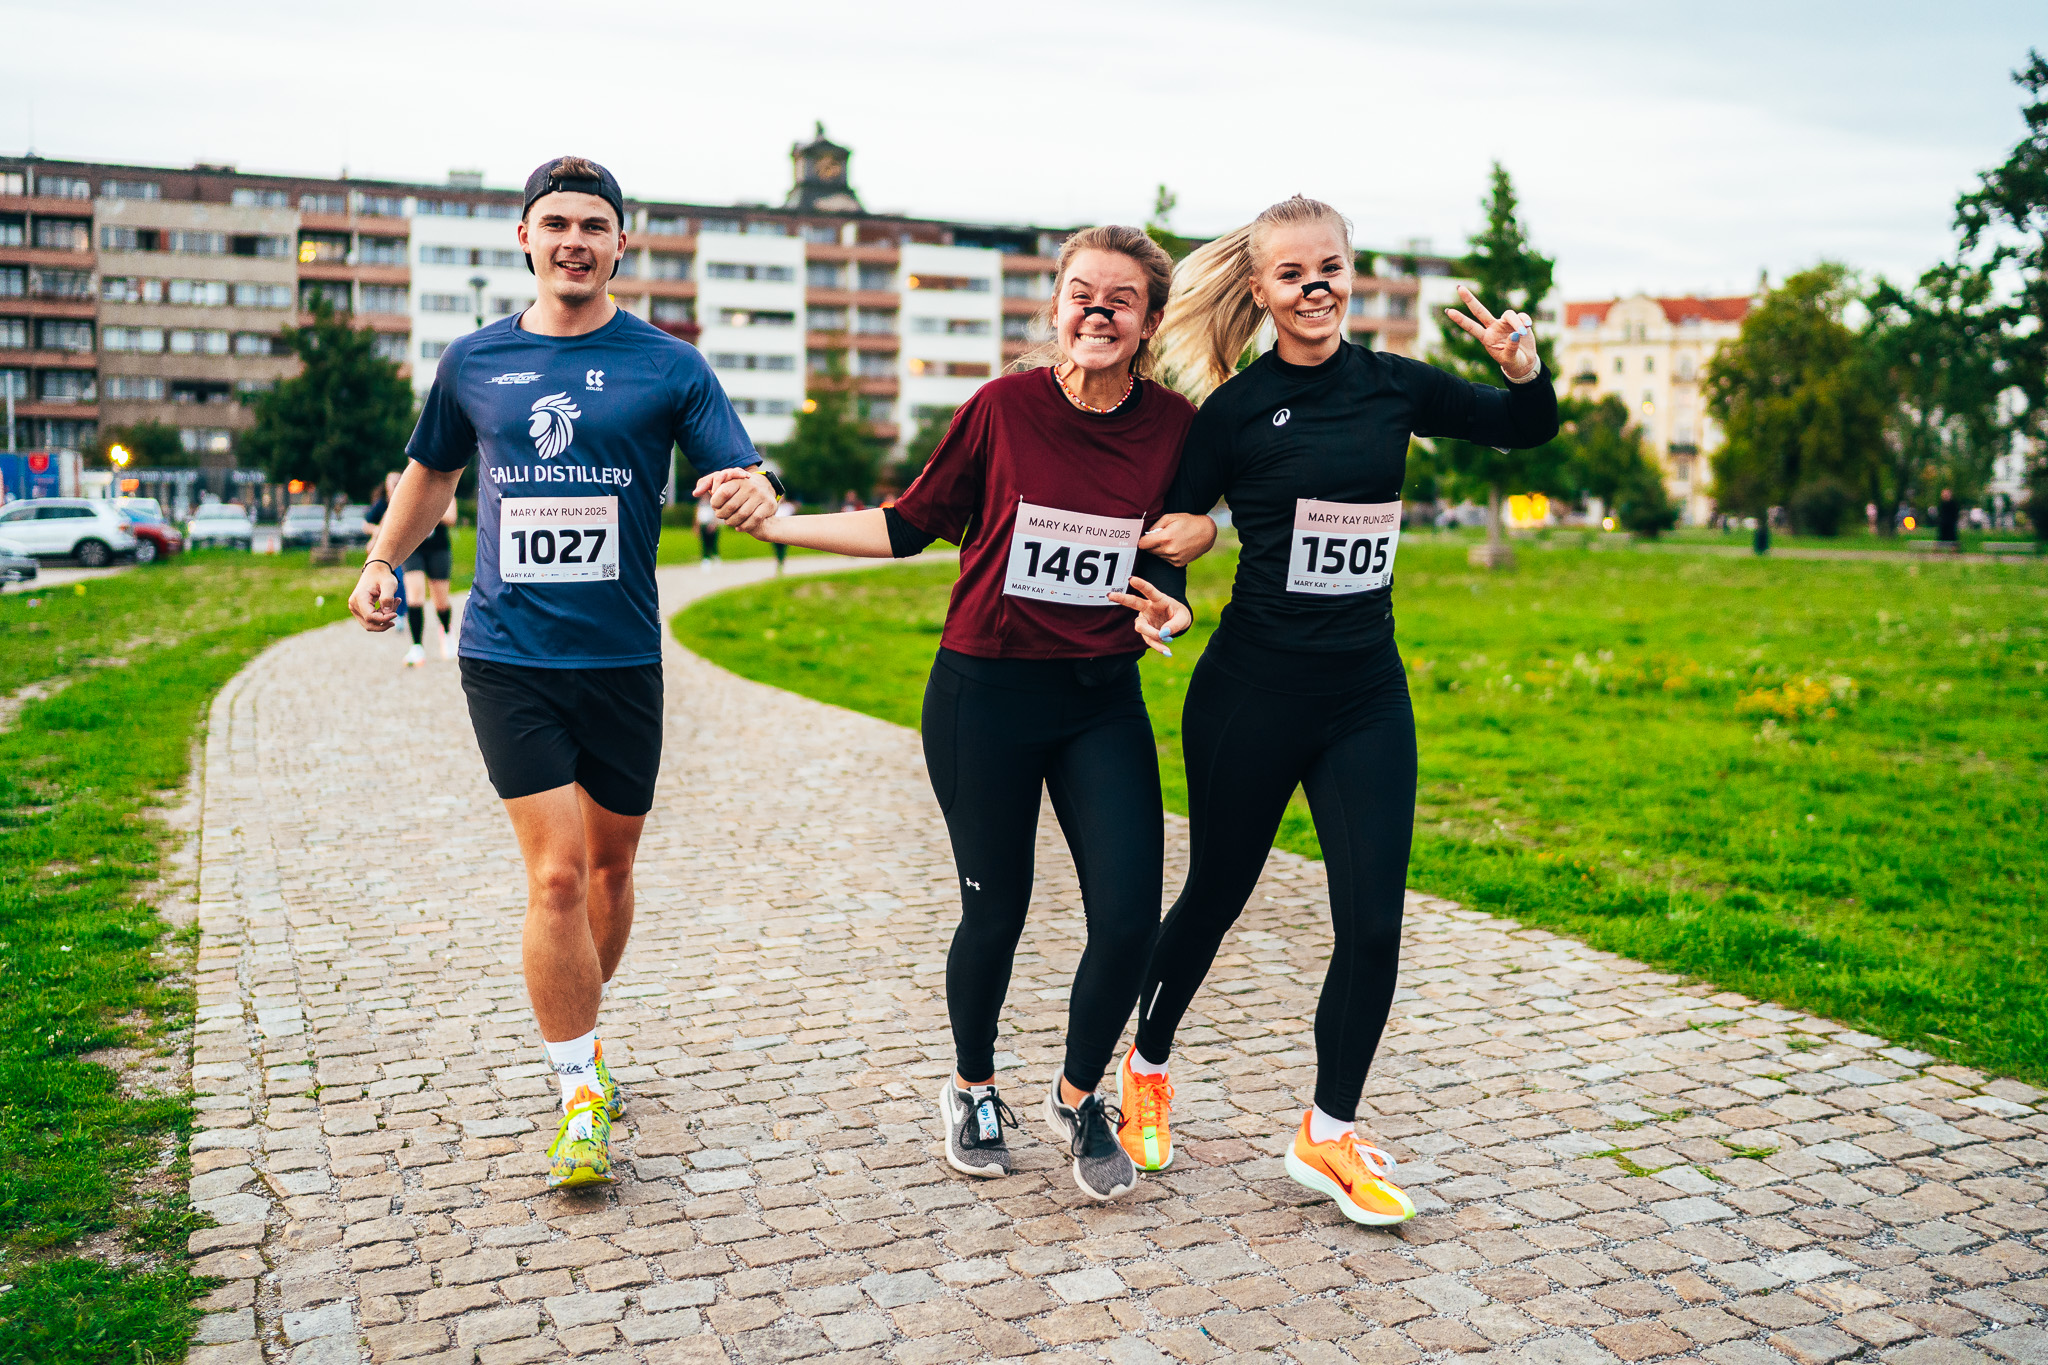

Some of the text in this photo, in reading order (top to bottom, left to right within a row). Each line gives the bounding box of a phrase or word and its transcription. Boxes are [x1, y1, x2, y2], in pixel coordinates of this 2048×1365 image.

[490, 465, 632, 487] GALLI DISTILLERY
[510, 506, 607, 517] MARY KAY RUN 2025
[1308, 512, 1395, 525] MARY KAY RUN 2025
[1029, 516, 1131, 539] MARY KAY RUN 2025
[511, 529, 607, 565] 1027
[1302, 536, 1390, 575] 1505
[1024, 541, 1120, 587] 1461
[1011, 583, 1031, 592] MARY
[1031, 586, 1045, 594] KAY
